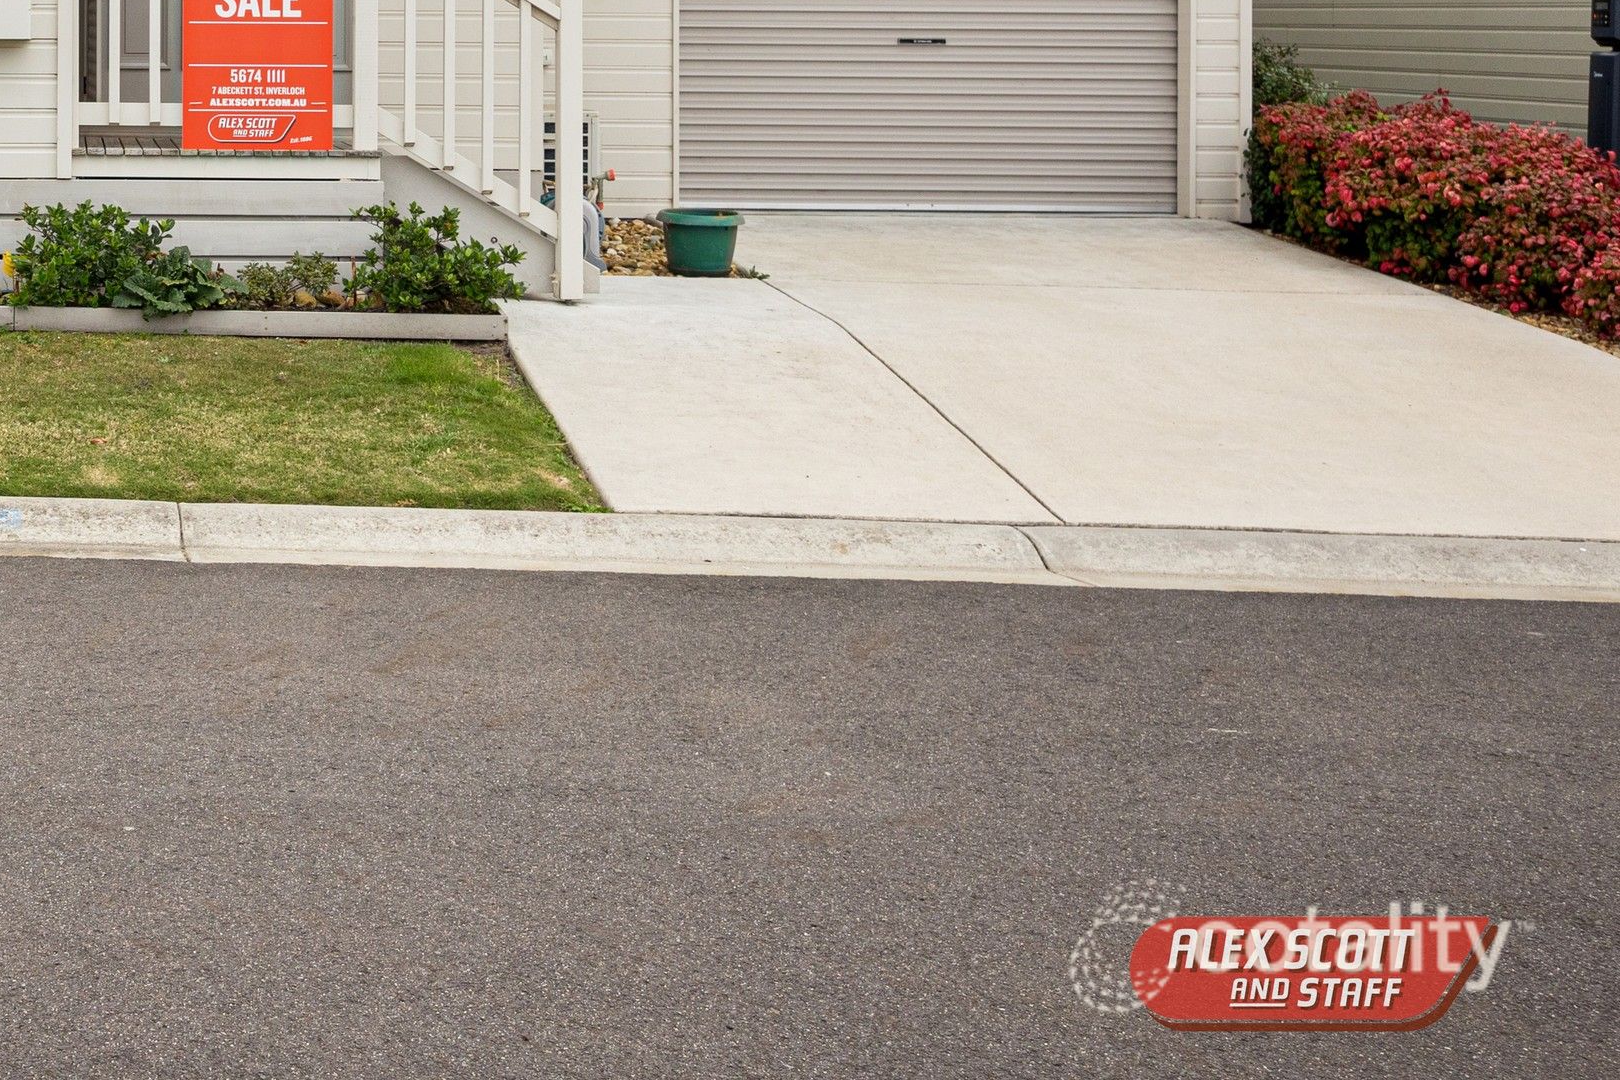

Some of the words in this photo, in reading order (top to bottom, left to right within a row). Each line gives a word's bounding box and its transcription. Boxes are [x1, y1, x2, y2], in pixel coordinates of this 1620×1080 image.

[230, 69, 262, 83] 5674
[212, 86, 217, 95] 7
[218, 86, 253, 95] ABECKETT
[266, 86, 305, 95] INVERLOCH
[209, 98, 307, 107] ALEXSCOTT.COM.AU
[218, 117, 244, 128] ALEX
[245, 117, 277, 129] SCOTT
[249, 129, 275, 137] STAFF
